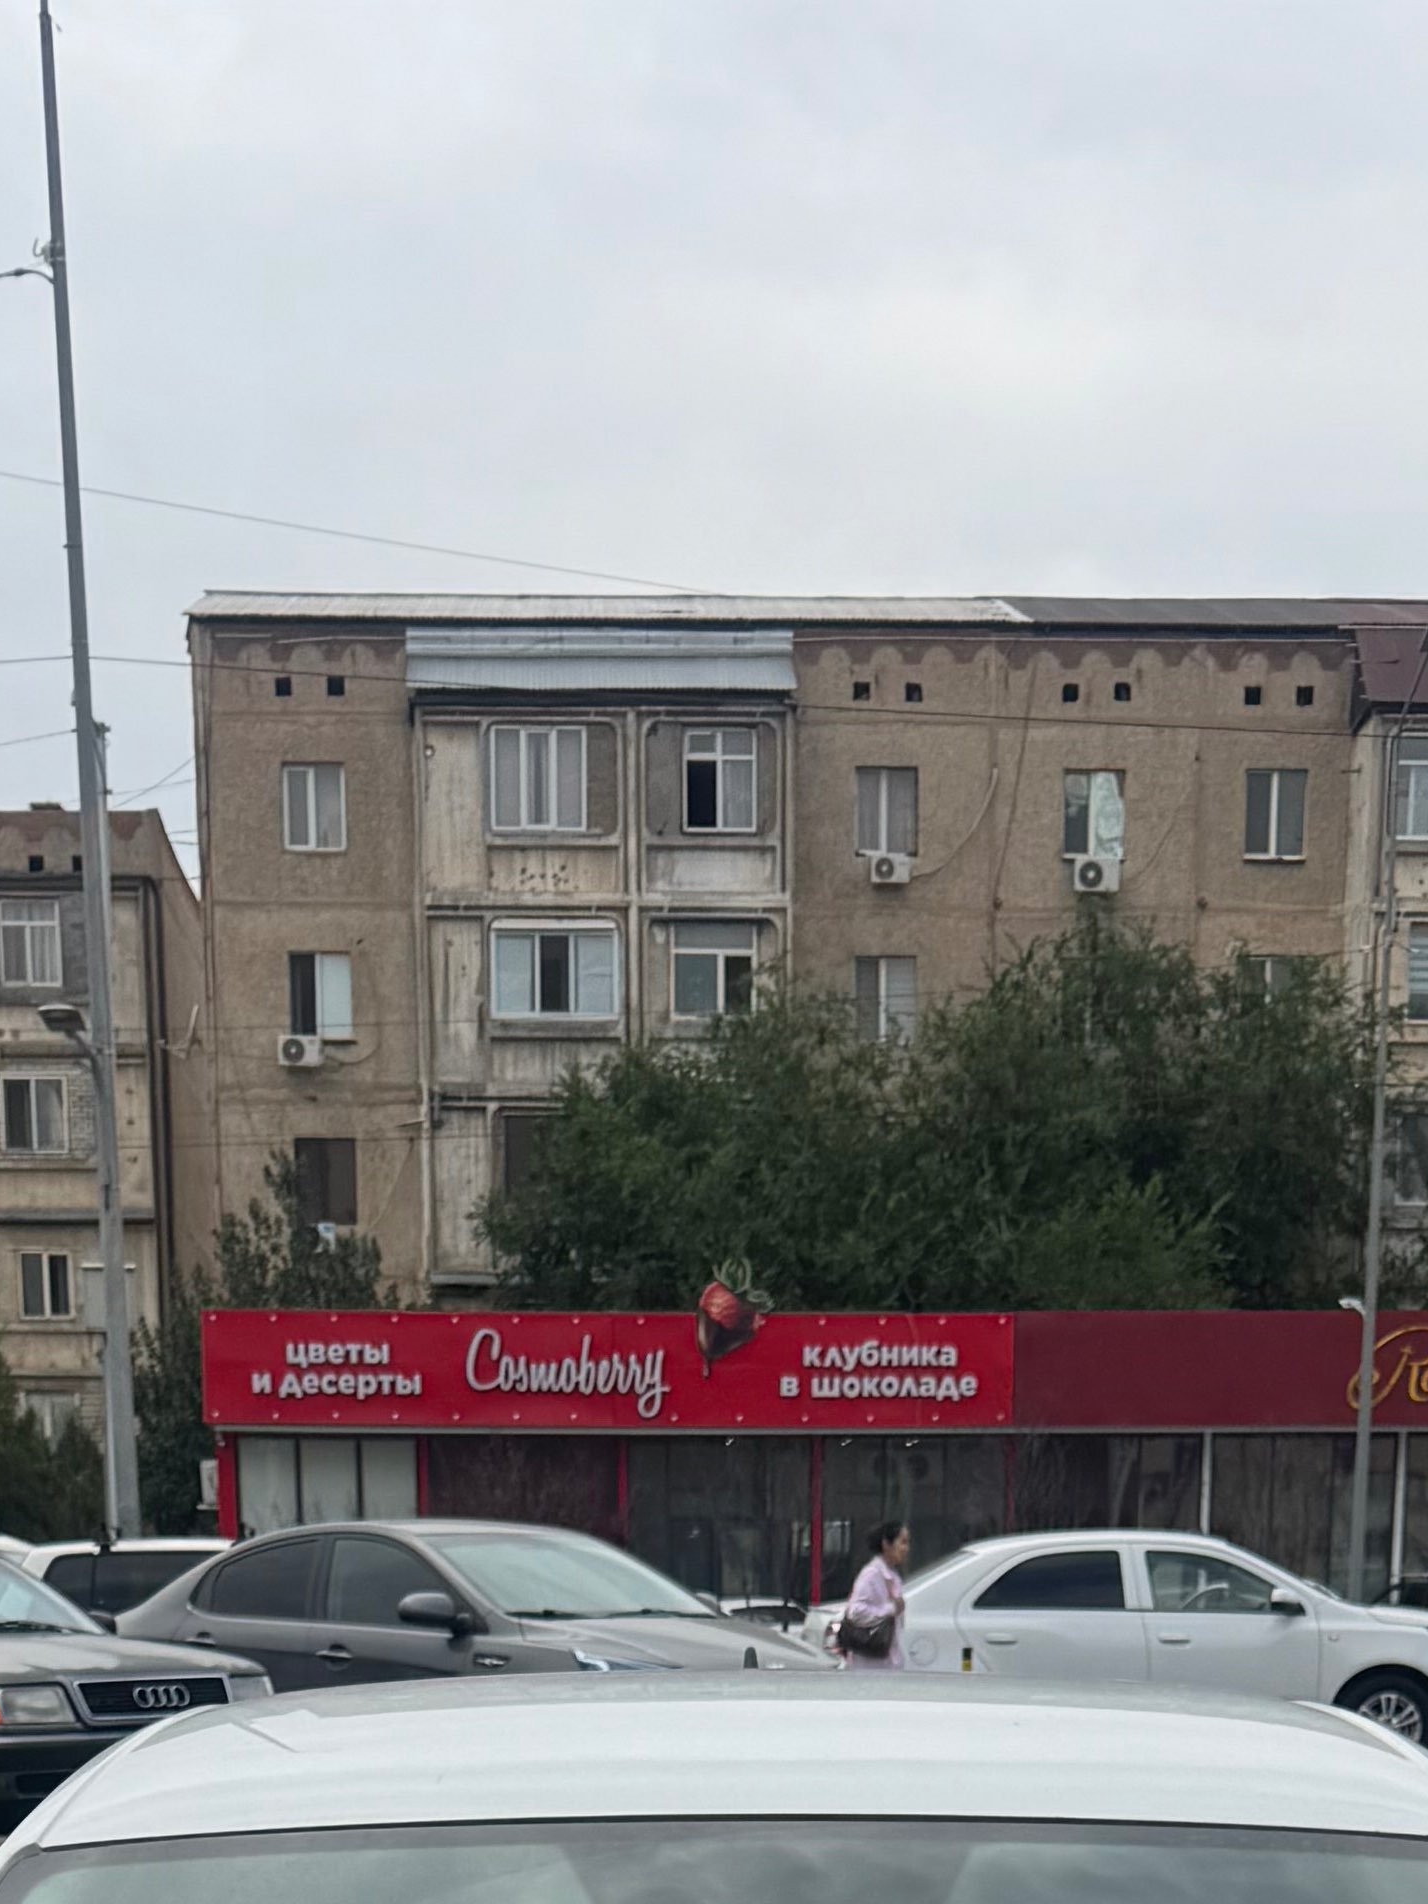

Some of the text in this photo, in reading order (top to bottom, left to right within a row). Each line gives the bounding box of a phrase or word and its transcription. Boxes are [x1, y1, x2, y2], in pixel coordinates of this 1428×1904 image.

[286, 1342, 390, 1369] цветы
[802, 1339, 958, 1372] клубника
[251, 1372, 422, 1400] и десерты
[465, 1328, 671, 1419] Cosmoberry
[780, 1375, 978, 1401] в шоколаде
